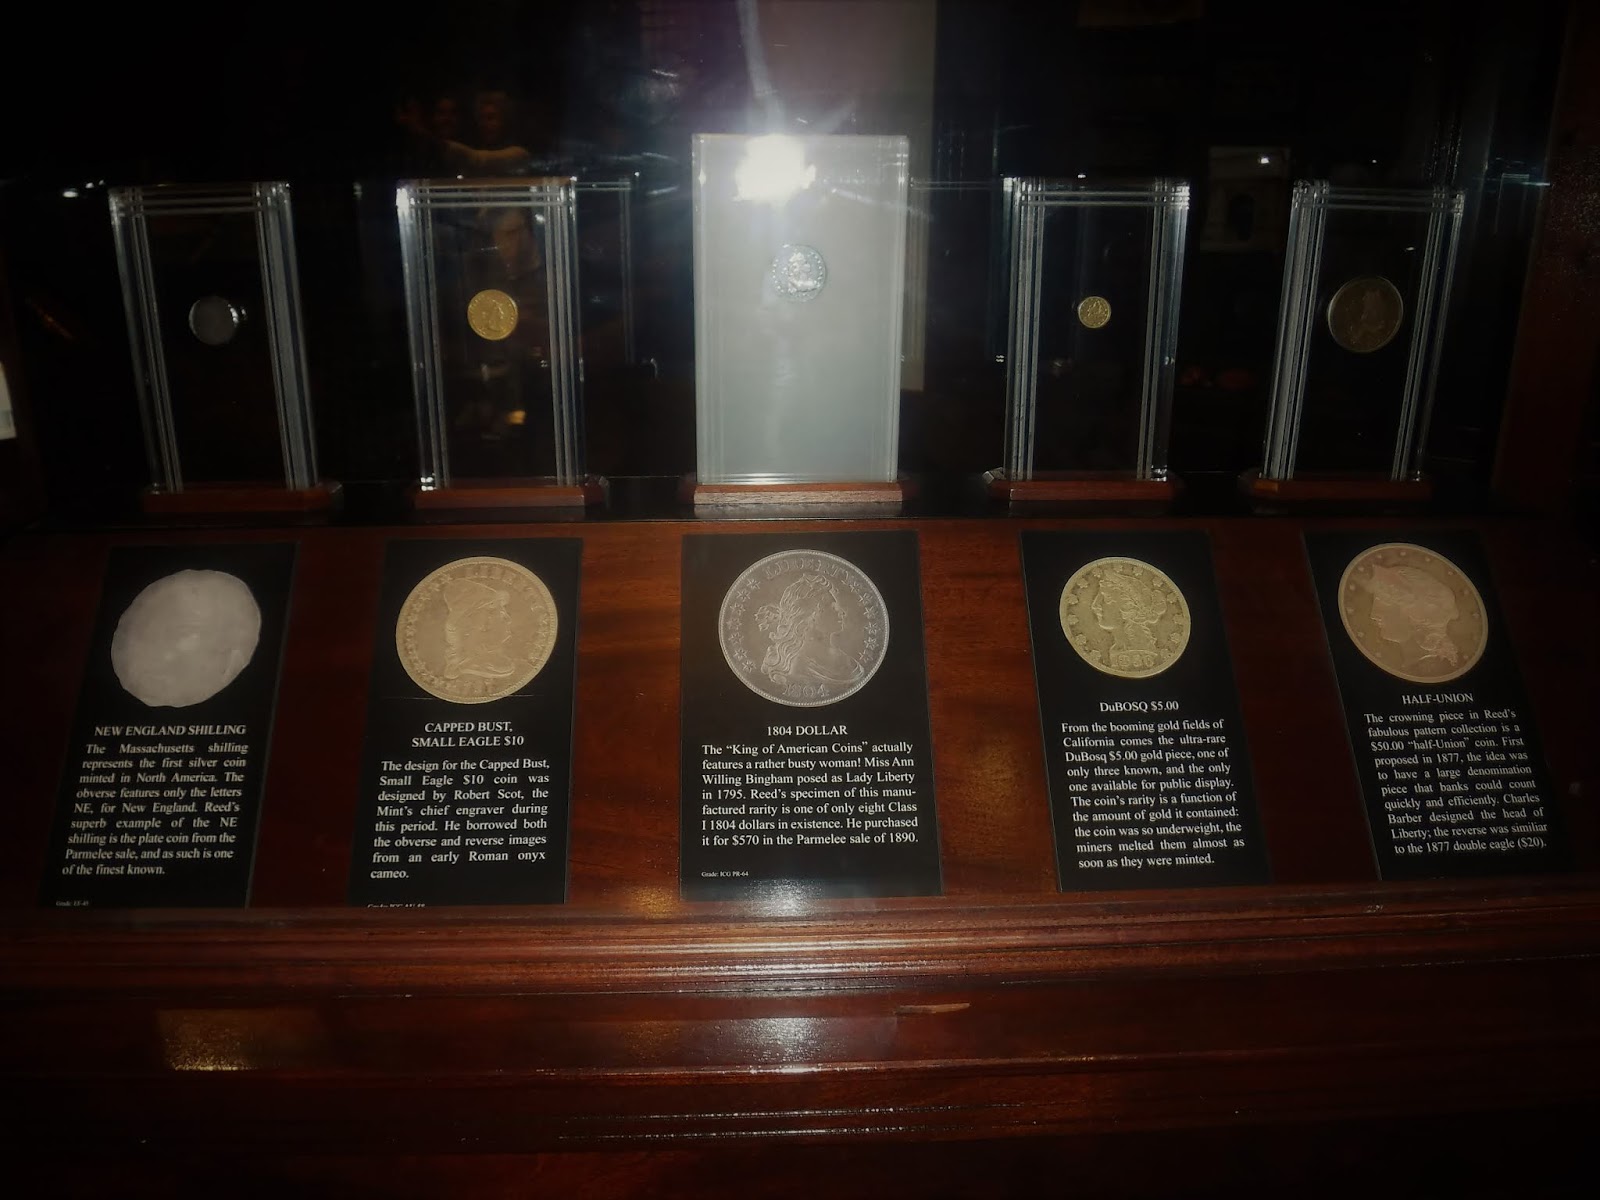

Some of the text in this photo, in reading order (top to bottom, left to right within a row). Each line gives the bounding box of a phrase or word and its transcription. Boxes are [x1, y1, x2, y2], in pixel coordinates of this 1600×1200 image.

[1402, 693, 1474, 705] HALF-UNION
[1100, 701, 1179, 713] DuBOSQ $5.00
[1363, 713, 1384, 724] The
[1389, 712, 1435, 724] crowning
[1439, 711, 1464, 723] piece
[1469, 710, 1479, 719] in
[95, 725, 246, 736] NEW ENGLAND SHILLING
[424, 721, 513, 732] CAPPED BUST,
[768, 725, 848, 736] 1804 DOLLAR
[1061, 719, 1224, 733] From the booming gold fields of
[1368, 727, 1410, 737] fabulous
[1413, 727, 1447, 738] pattern
[1451, 723, 1497, 735] collection
[1501, 723, 1510, 732] is
[412, 735, 524, 747] SMALL EAGLE $10
[1063, 734, 1226, 747] California comes the ultra-rare
[1370, 741, 1404, 752] $50.00
[1474, 737, 1498, 747] coin.
[1501, 736, 1524, 746] First
[86, 742, 249, 755] The Massachusetts shilling
[701, 744, 722, 755] The
[762, 744, 775, 754] of
[777, 743, 828, 754] American
[872, 741, 913, 754] actually
[82, 757, 247, 771] represents the first silver coin
[702, 757, 914, 771] features a rather busty woman! Miss Ann
[1374, 751, 1528, 768] proposed in 1877, the idea was
[79, 771, 245, 783] minted in North America. The
[1067, 762, 1231, 779] only three known, and the only
[379, 773, 550, 788] Small Eagle $10 coin was
[702, 771, 915, 787] Willing Bingham posed as Lady Liberty
[1068, 777, 1234, 792] one available for public display.
[1381, 779, 1536, 797] piece that banks could count
[378, 788, 549, 803] designed by Robert Scot, the
[74, 801, 240, 815] NE, for New England. Reed's
[420, 805, 451, 816] chief
[456, 807, 505, 818] engraver
[511, 803, 548, 816] during
[71, 817, 238, 831] superb example of the NE
[375, 818, 547, 834] this period. He borrowed both
[702, 832, 918, 846] it for $570 in the Parmelee sale of 1890.
[1391, 828, 1432, 840] Liberty;
[1433, 826, 1449, 837] the
[1451, 827, 1487, 836] reverse
[1489, 826, 1509, 834] was
[1076, 838, 1245, 853] miners melted them almost as
[1078, 853, 1215, 869] soon as they were minted.
